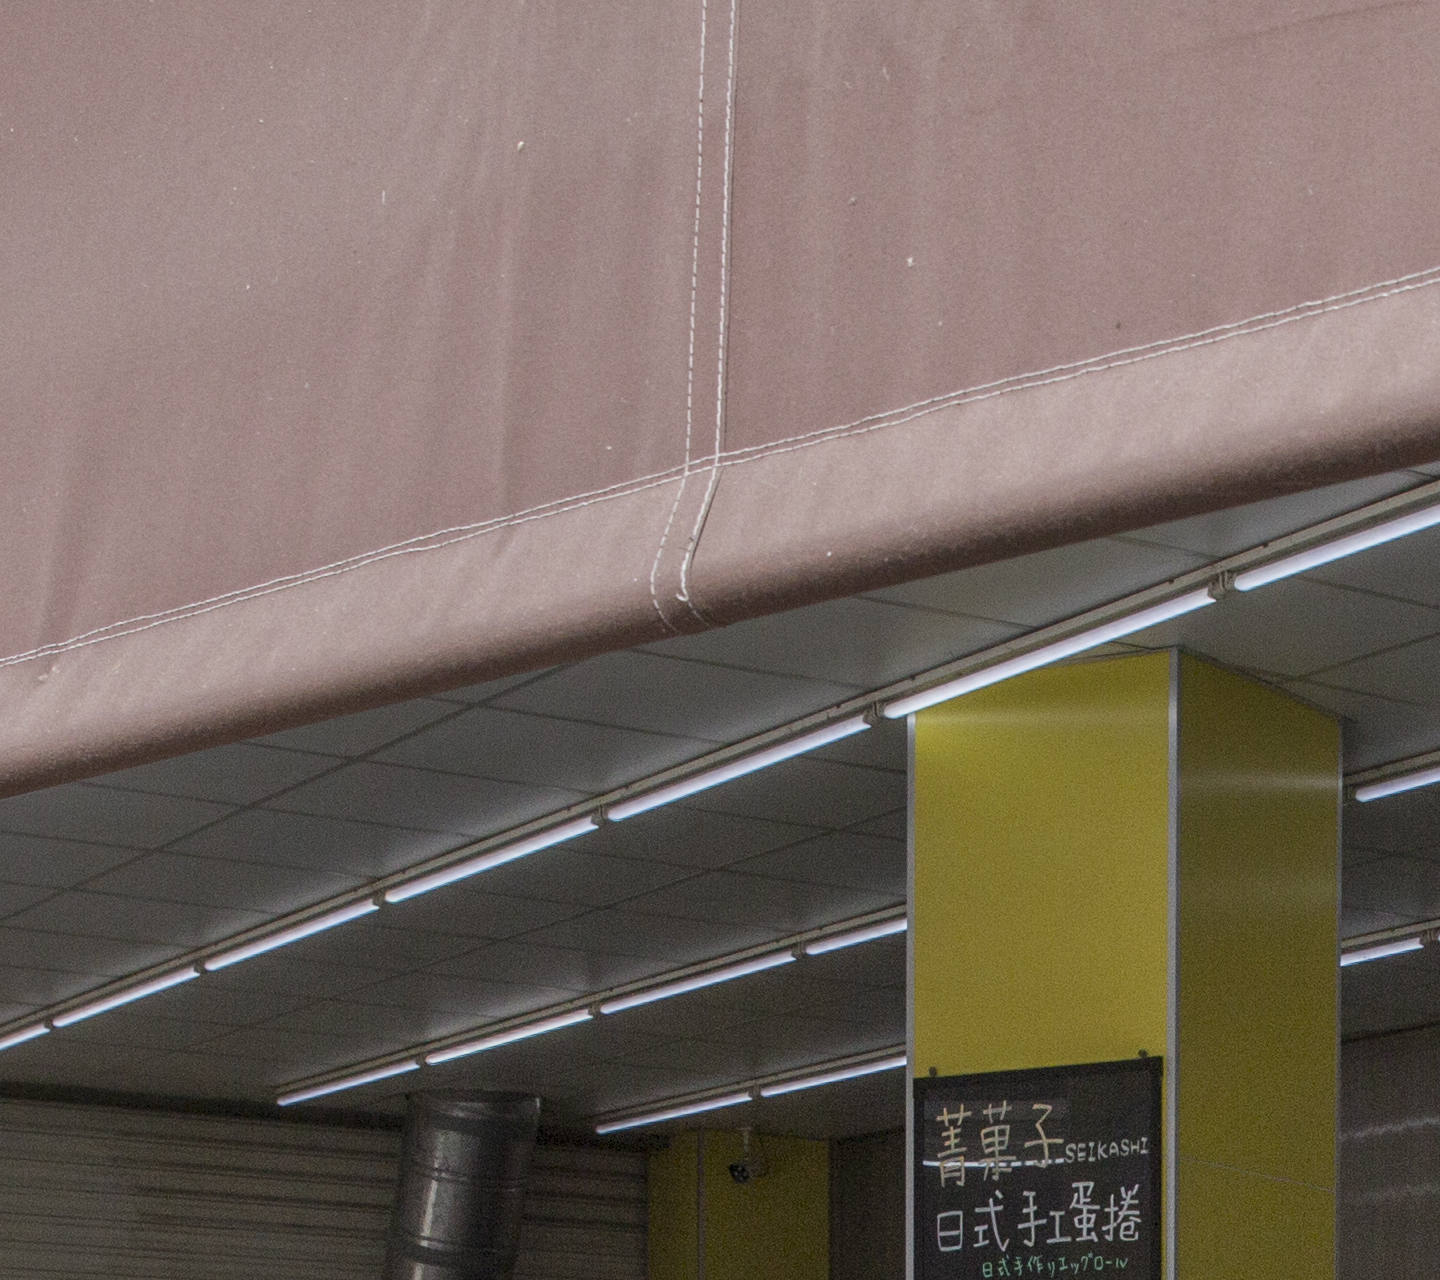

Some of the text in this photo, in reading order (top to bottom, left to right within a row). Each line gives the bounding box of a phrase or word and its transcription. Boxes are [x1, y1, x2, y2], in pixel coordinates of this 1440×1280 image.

[1065, 1137, 1149, 1163] SEIKASHI
[937, 1181, 1142, 1252] 日式手工蛋捲
